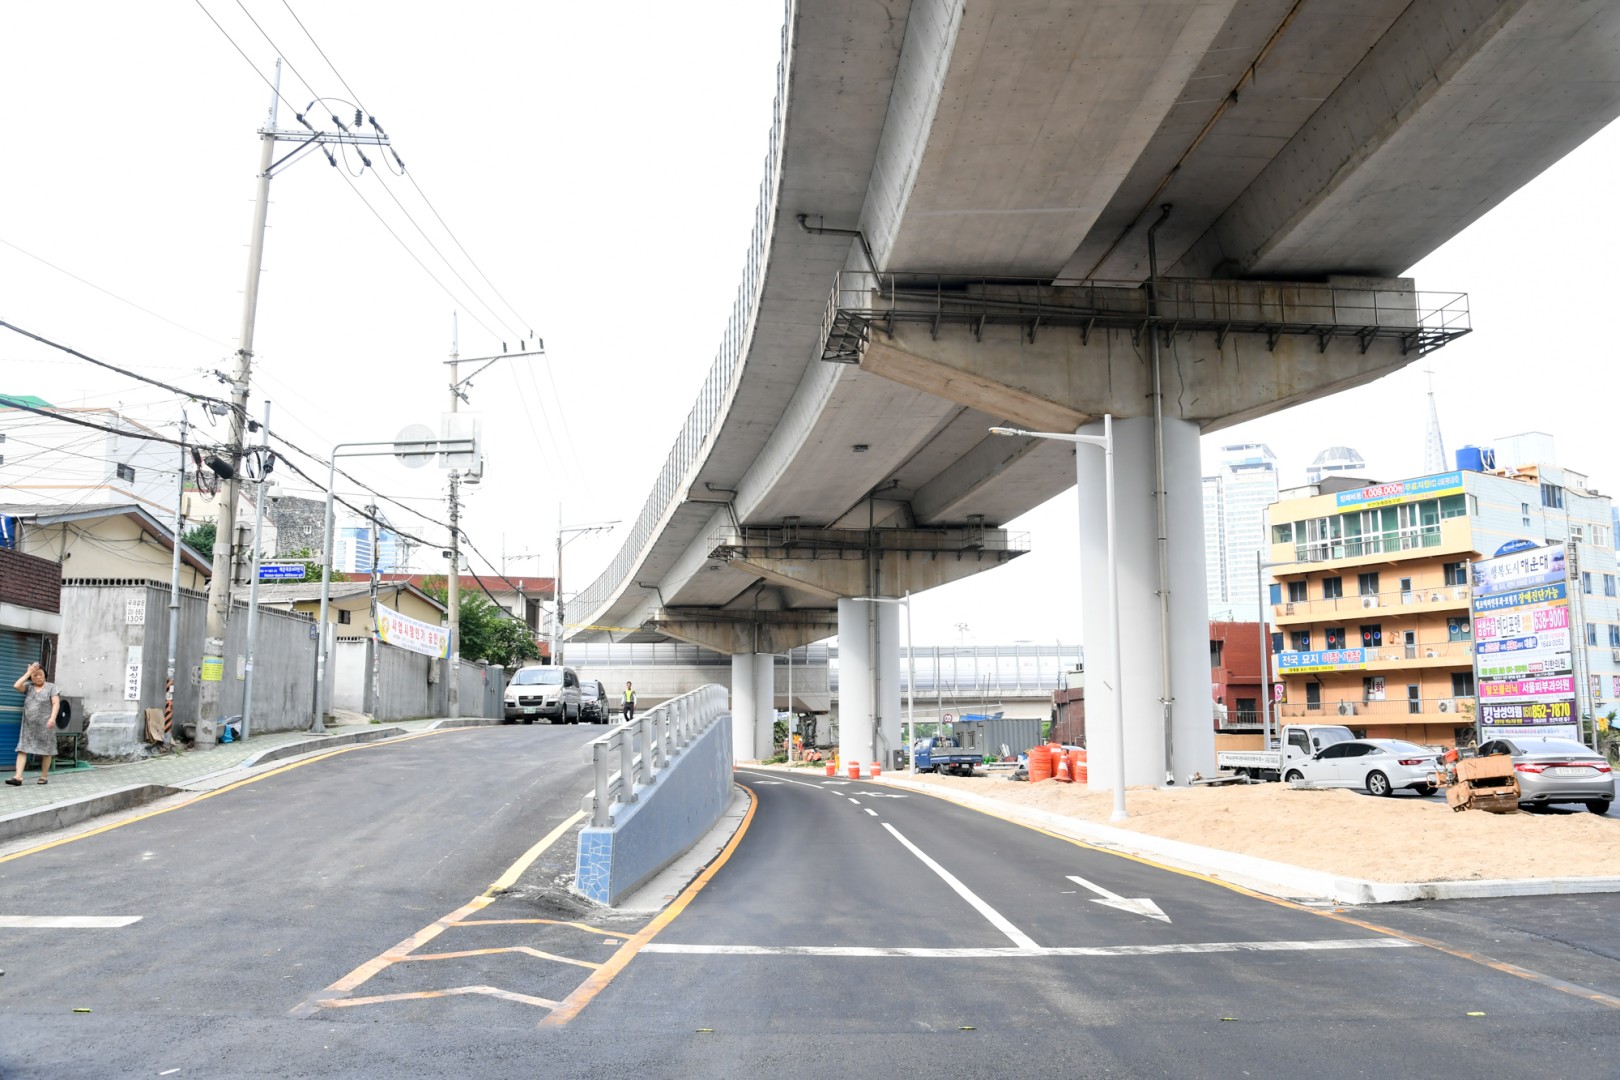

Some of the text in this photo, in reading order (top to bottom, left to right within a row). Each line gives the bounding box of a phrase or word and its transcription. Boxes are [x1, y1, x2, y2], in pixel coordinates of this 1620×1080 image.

[1491, 554, 1549, 580] 행복도시 해운대
[1518, 587, 1559, 605] 장애진단가능
[1534, 609, 1566, 630] 638-9001
[1282, 653, 1299, 666] 전국
[1301, 653, 1319, 665] 묘지
[1544, 658, 1566, 670] 진한의원
[1522, 679, 1570, 693] 서울피부과의원
